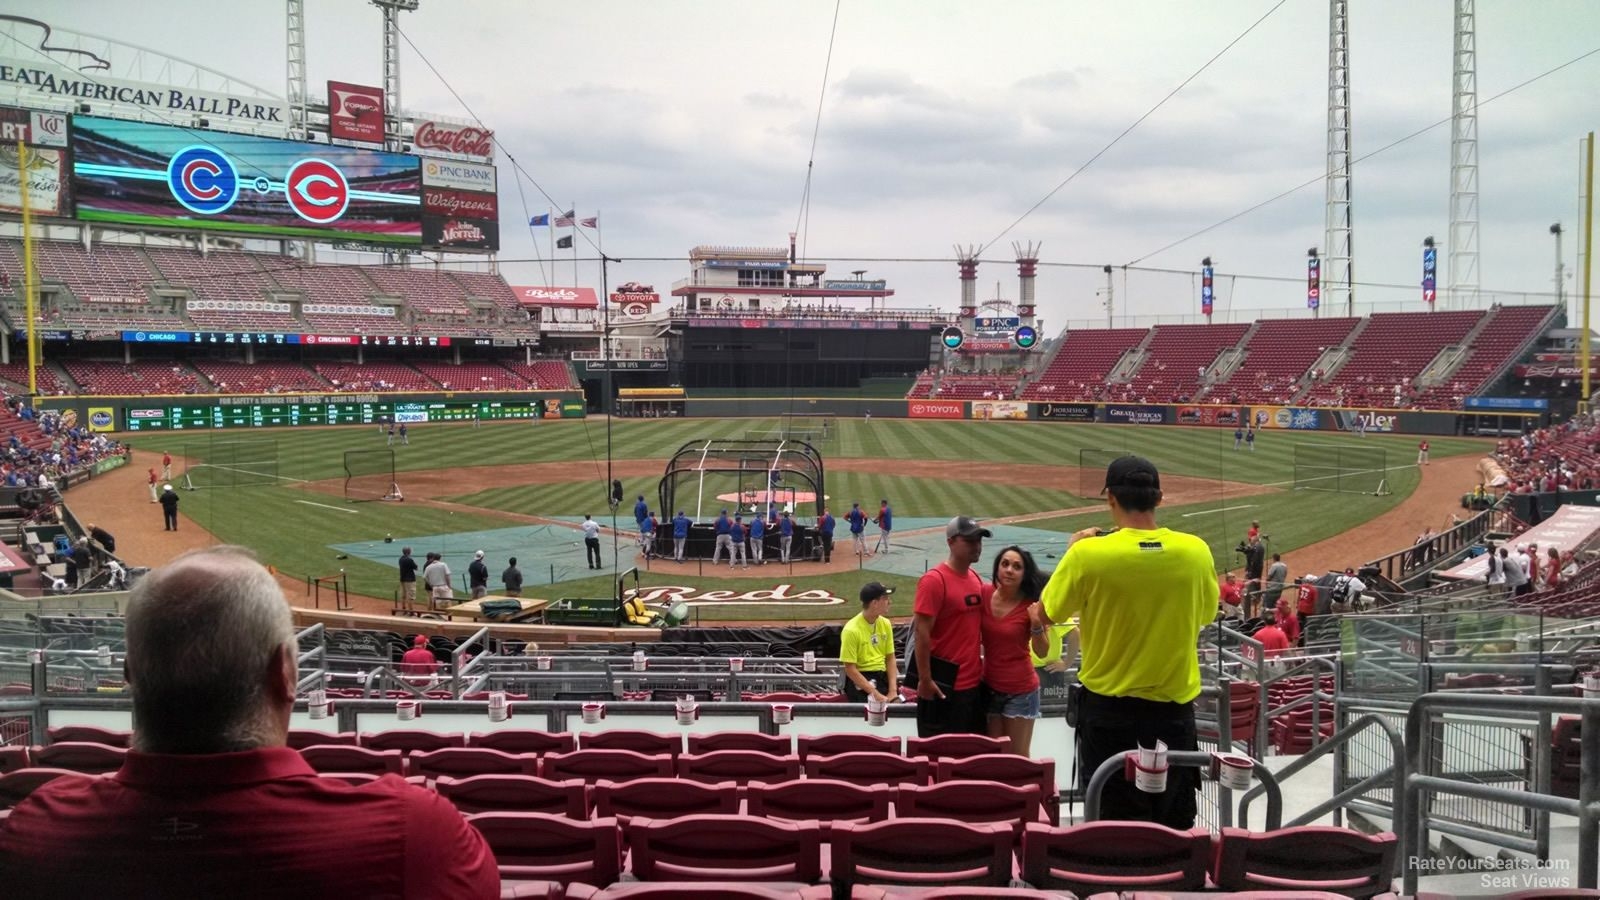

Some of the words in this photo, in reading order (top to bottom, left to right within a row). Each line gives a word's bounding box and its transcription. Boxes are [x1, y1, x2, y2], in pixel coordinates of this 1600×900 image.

[0, 66, 47, 85] EAT
[227, 98, 283, 122] PARK
[0, 122, 27, 140] RT
[440, 166, 463, 177] PNC
[464, 168, 490, 180] BANK
[425, 193, 493, 211] Walgreens
[438, 227, 485, 243] Morrell
[991, 318, 1011, 326] PNC
[1247, 646, 1255, 660] 23
[1406, 640, 1415, 653] 24
